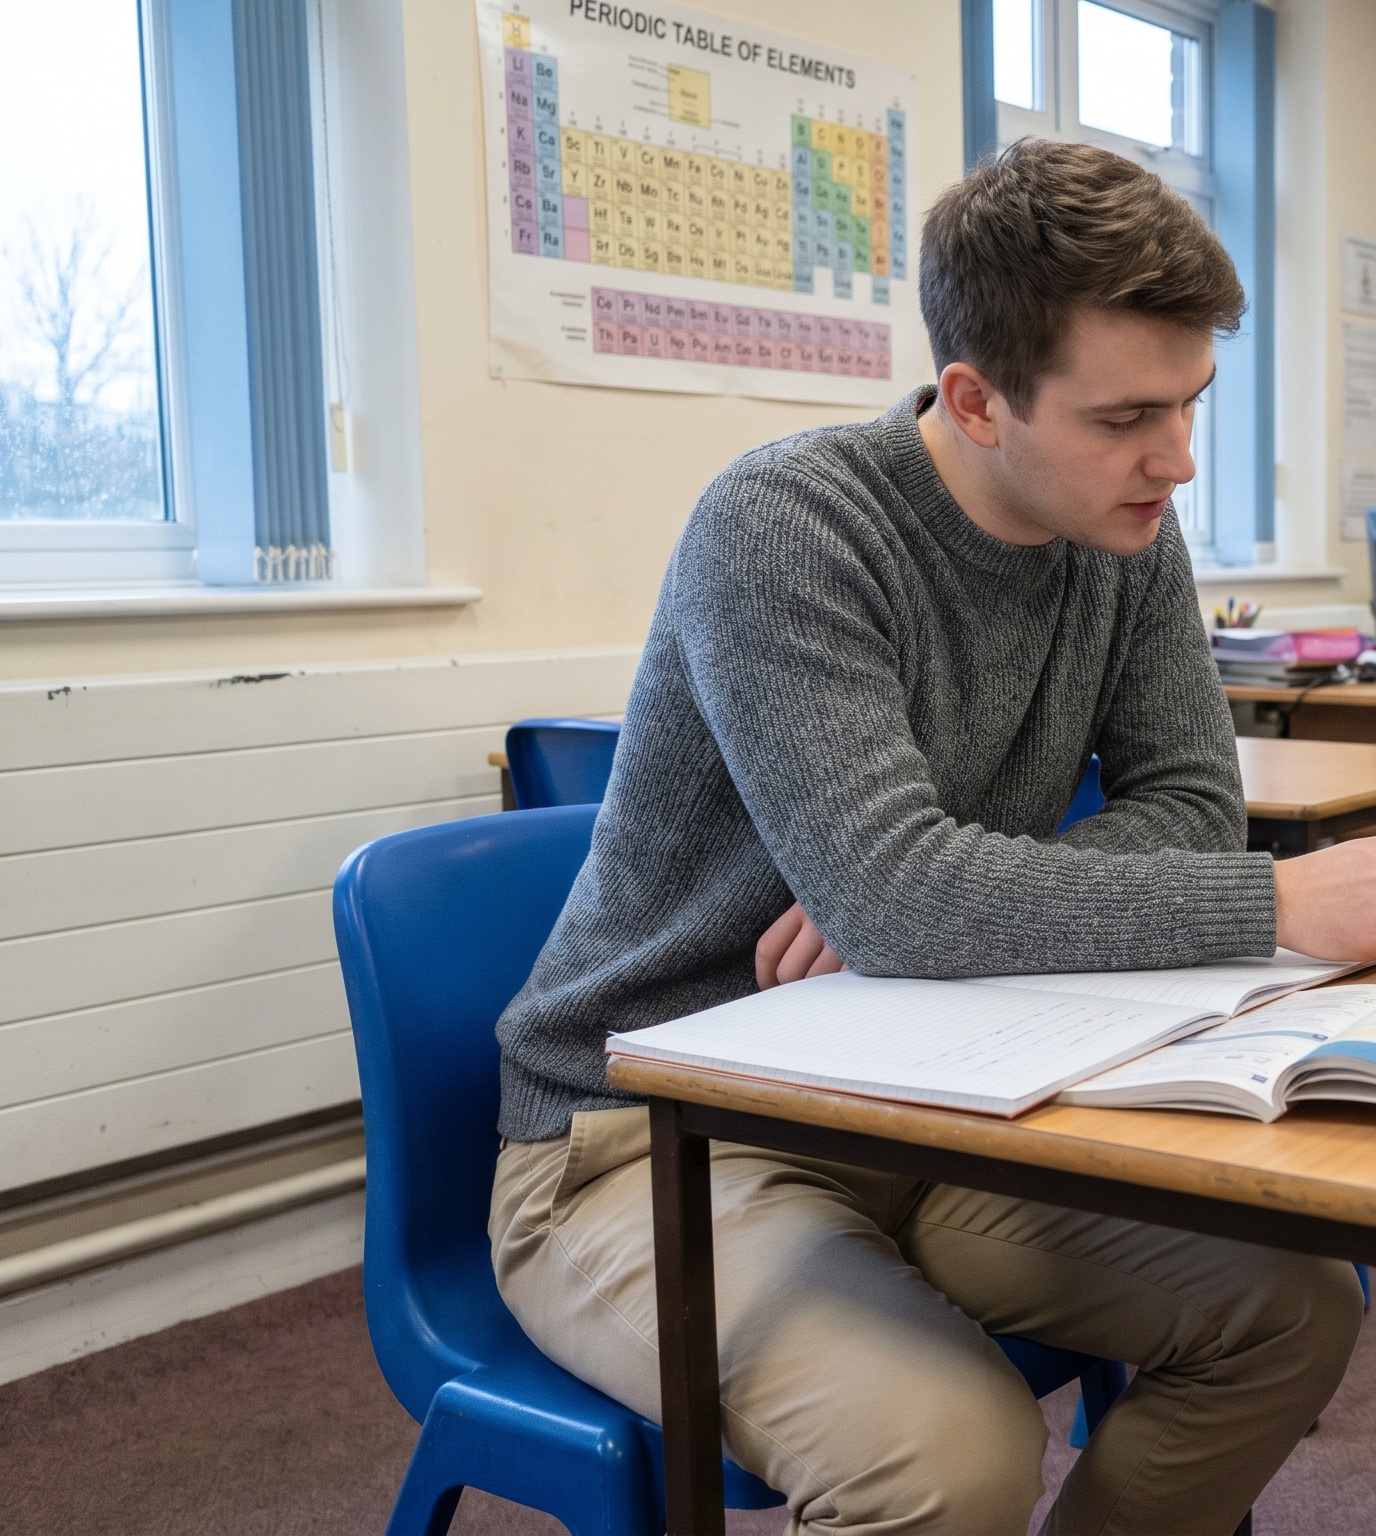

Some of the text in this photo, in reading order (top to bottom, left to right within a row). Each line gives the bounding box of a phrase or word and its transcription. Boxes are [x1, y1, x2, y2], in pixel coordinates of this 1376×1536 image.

[569, 0, 856, 89] PERIODIC TABLE OF ELEMENTS
[511, 91, 529, 107] Na
[516, 126, 526, 142] K
[538, 131, 556, 147] Ca
[565, 136, 581, 151] Sc
[620, 146, 628, 160] V
[640, 150, 655, 165] Cr
[663, 155, 681, 169] Mn
[513, 159, 532, 176] Rb
[570, 170, 579, 183] Y
[616, 179, 633, 194] Nb
[650, 334, 659, 347] U
